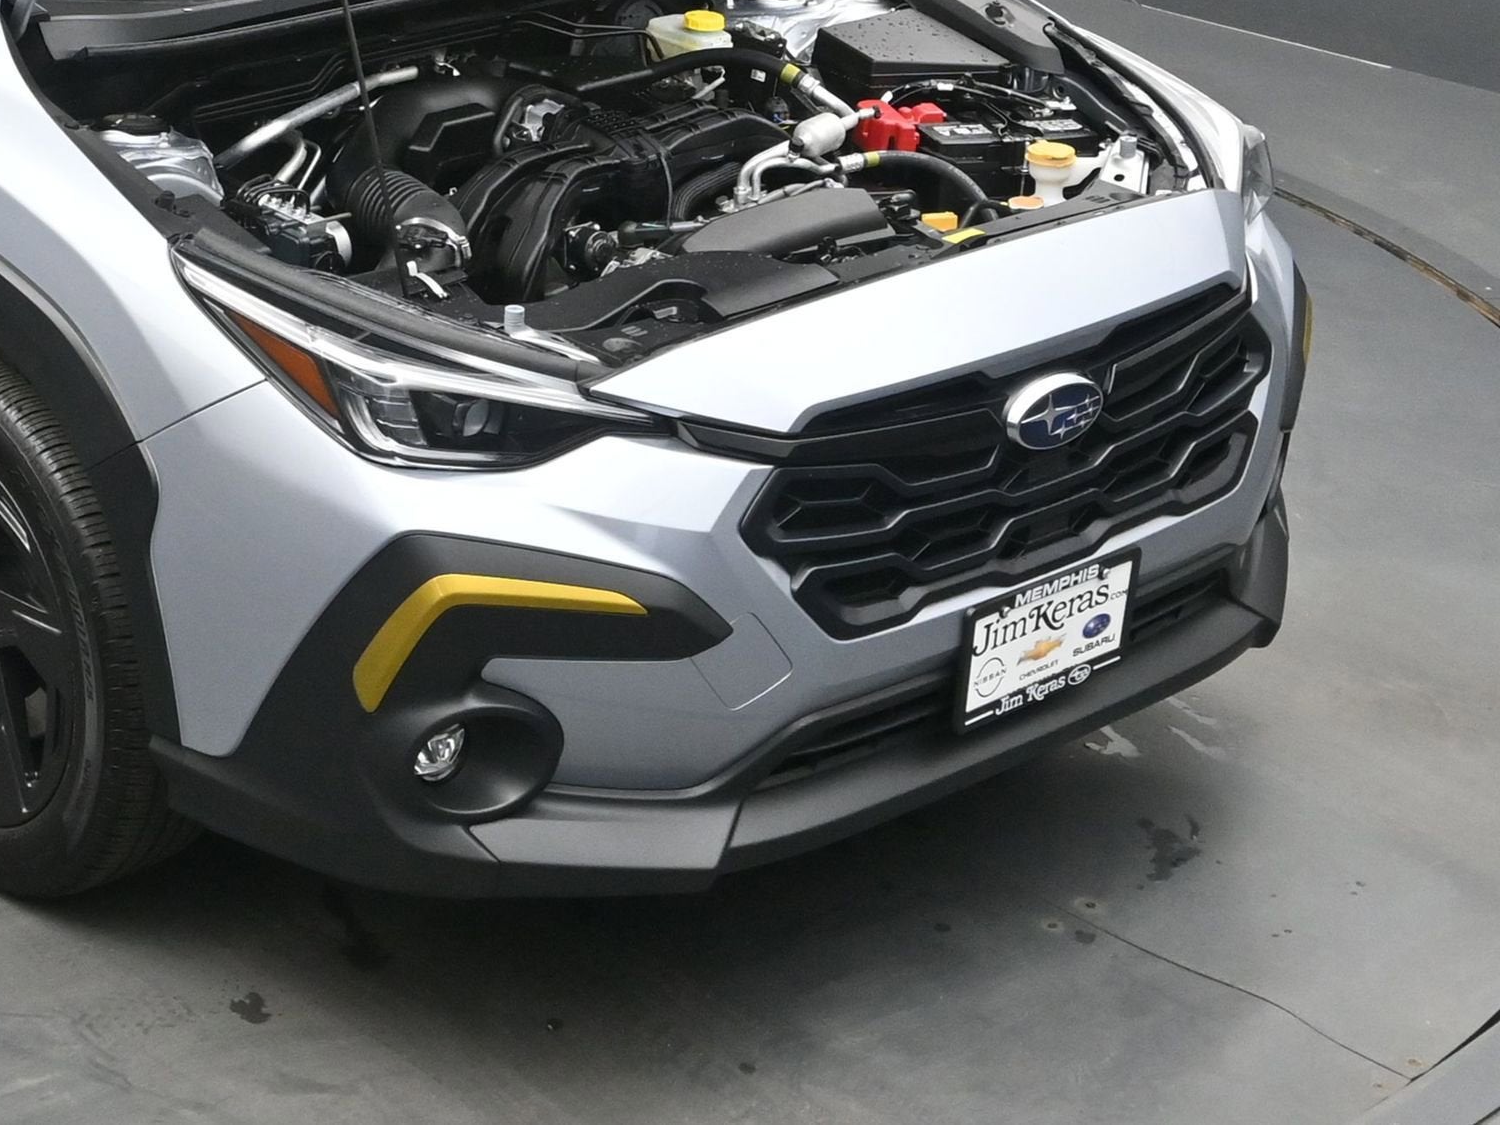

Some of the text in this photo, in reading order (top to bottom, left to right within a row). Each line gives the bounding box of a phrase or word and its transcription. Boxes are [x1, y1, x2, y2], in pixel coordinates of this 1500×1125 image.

[1014, 563, 1100, 608] MEMPHIS
[1072, 633, 1116, 657] SUBARU
[973, 668, 1008, 688] NISSAN
[1018, 659, 1059, 681] CHEVROLET
[995, 675, 1066, 715] Jim Keras
